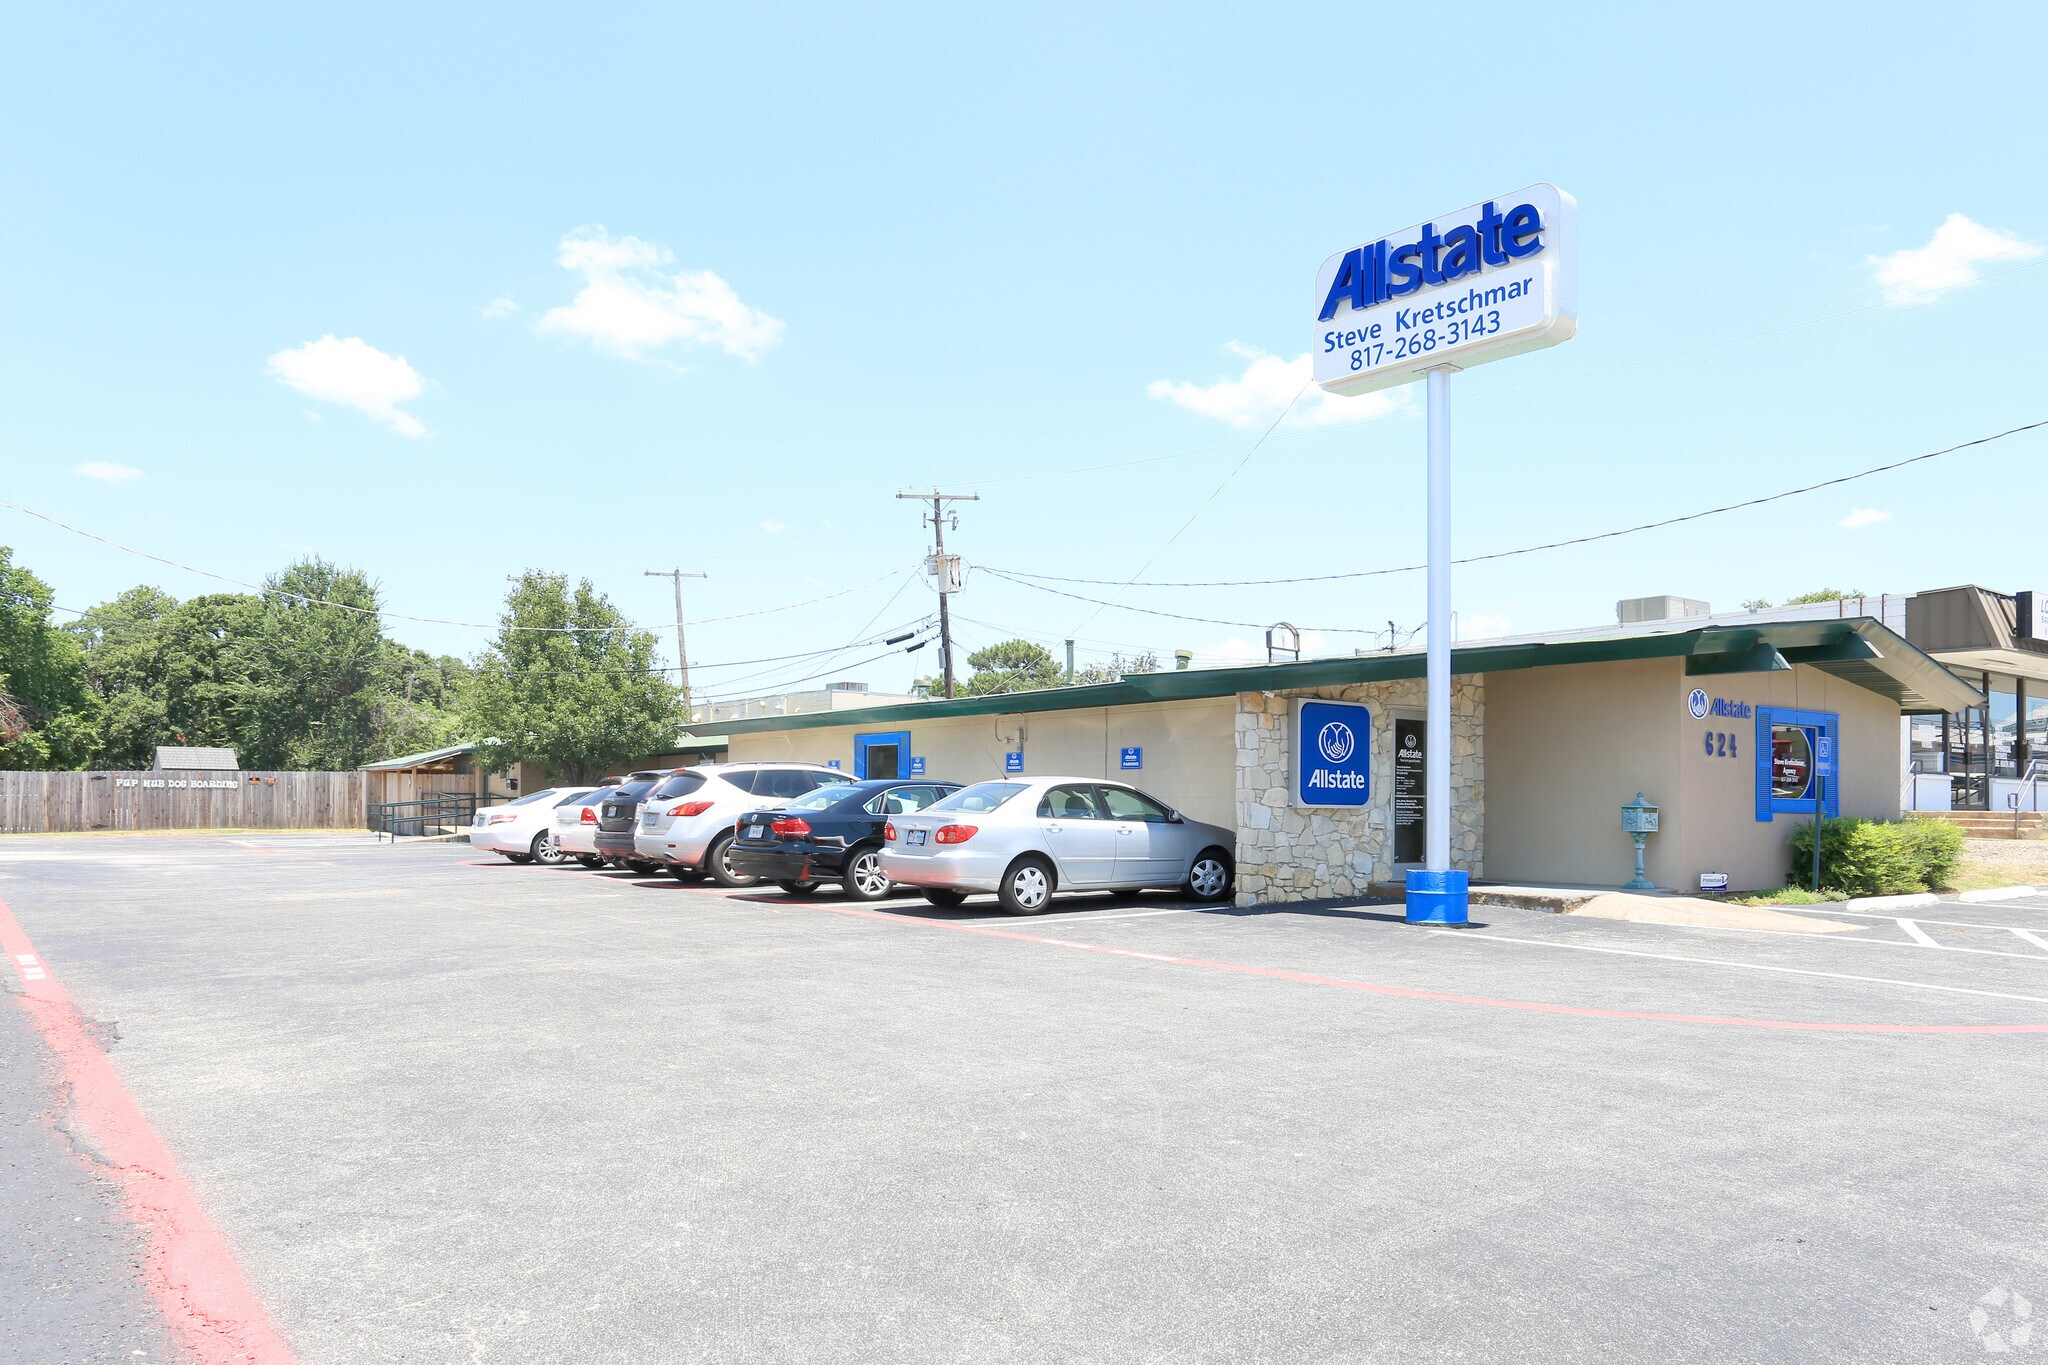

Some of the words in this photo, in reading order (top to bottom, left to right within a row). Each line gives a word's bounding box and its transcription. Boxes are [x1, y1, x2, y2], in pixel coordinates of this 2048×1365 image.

[1317, 201, 1545, 322] Allstate
[1324, 323, 1382, 353] Steve
[1396, 277, 1533, 332] Kretschmar
[1350, 310, 1500, 371] 817-268-3143
[1709, 697, 1752, 720] Allstate
[1397, 748, 1423, 759] Allstate
[116, 778, 139, 788] PUP
[143, 779, 165, 788] HUB
[168, 780, 187, 788] DOG
[190, 780, 239, 789] BOARDING
[1308, 768, 1365, 789] Allstate
